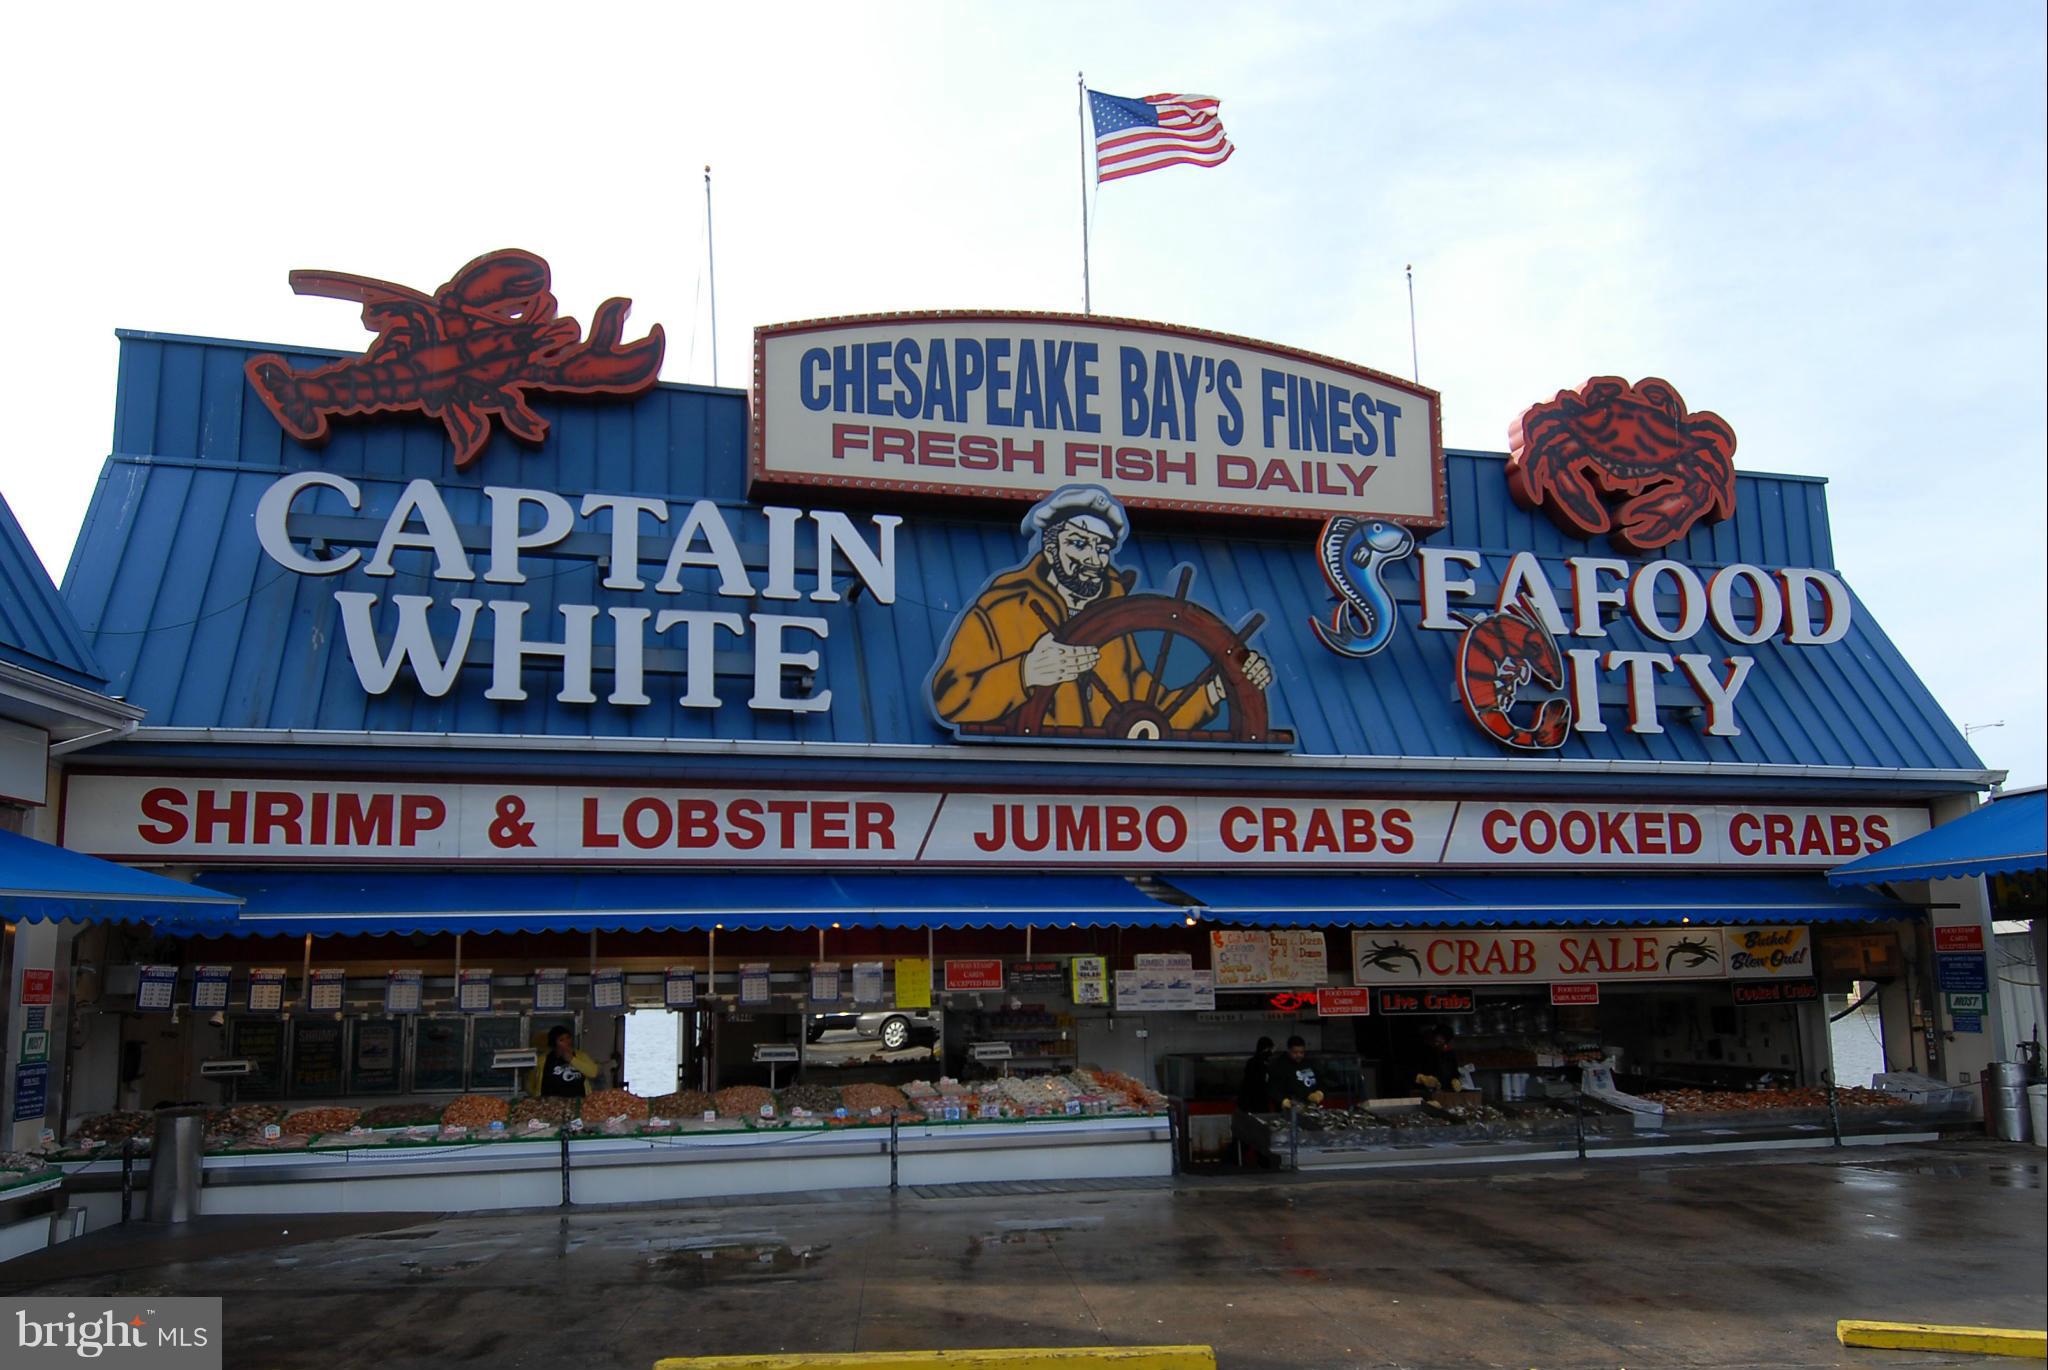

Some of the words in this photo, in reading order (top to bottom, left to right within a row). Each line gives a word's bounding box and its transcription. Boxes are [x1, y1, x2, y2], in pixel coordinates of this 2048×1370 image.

[800, 337, 1101, 434] CHESAPEAKE
[1119, 345, 1244, 447] BAY'S
[1261, 367, 1402, 457] FINEST
[832, 423, 1044, 474] FRESH
[1065, 442, 1197, 486] FISH
[1217, 454, 1378, 497] DAILY
[255, 471, 903, 604] CAPTAIN
[334, 591, 833, 712] WHITE
[137, 787, 446, 846] SHRIMP
[488, 794, 538, 849] &
[582, 797, 896, 850] LOBSTER
[973, 804, 1188, 853] JUMBO
[1219, 806, 1414, 855] CRABS
[1482, 809, 1702, 855] COOKED
[1729, 813, 1892, 857] CRABS
[1426, 938, 1537, 976] CRAB
[1558, 937, 1660, 974] SALE
[1731, 951, 1769, 970] Blow
[1770, 947, 1808, 968] Out!
[1744, 929, 1793, 949] Bushel
[1383, 993, 1418, 1009] Live
[1424, 992, 1472, 1009] Crabs
[1953, 996, 1979, 1006] MOST
